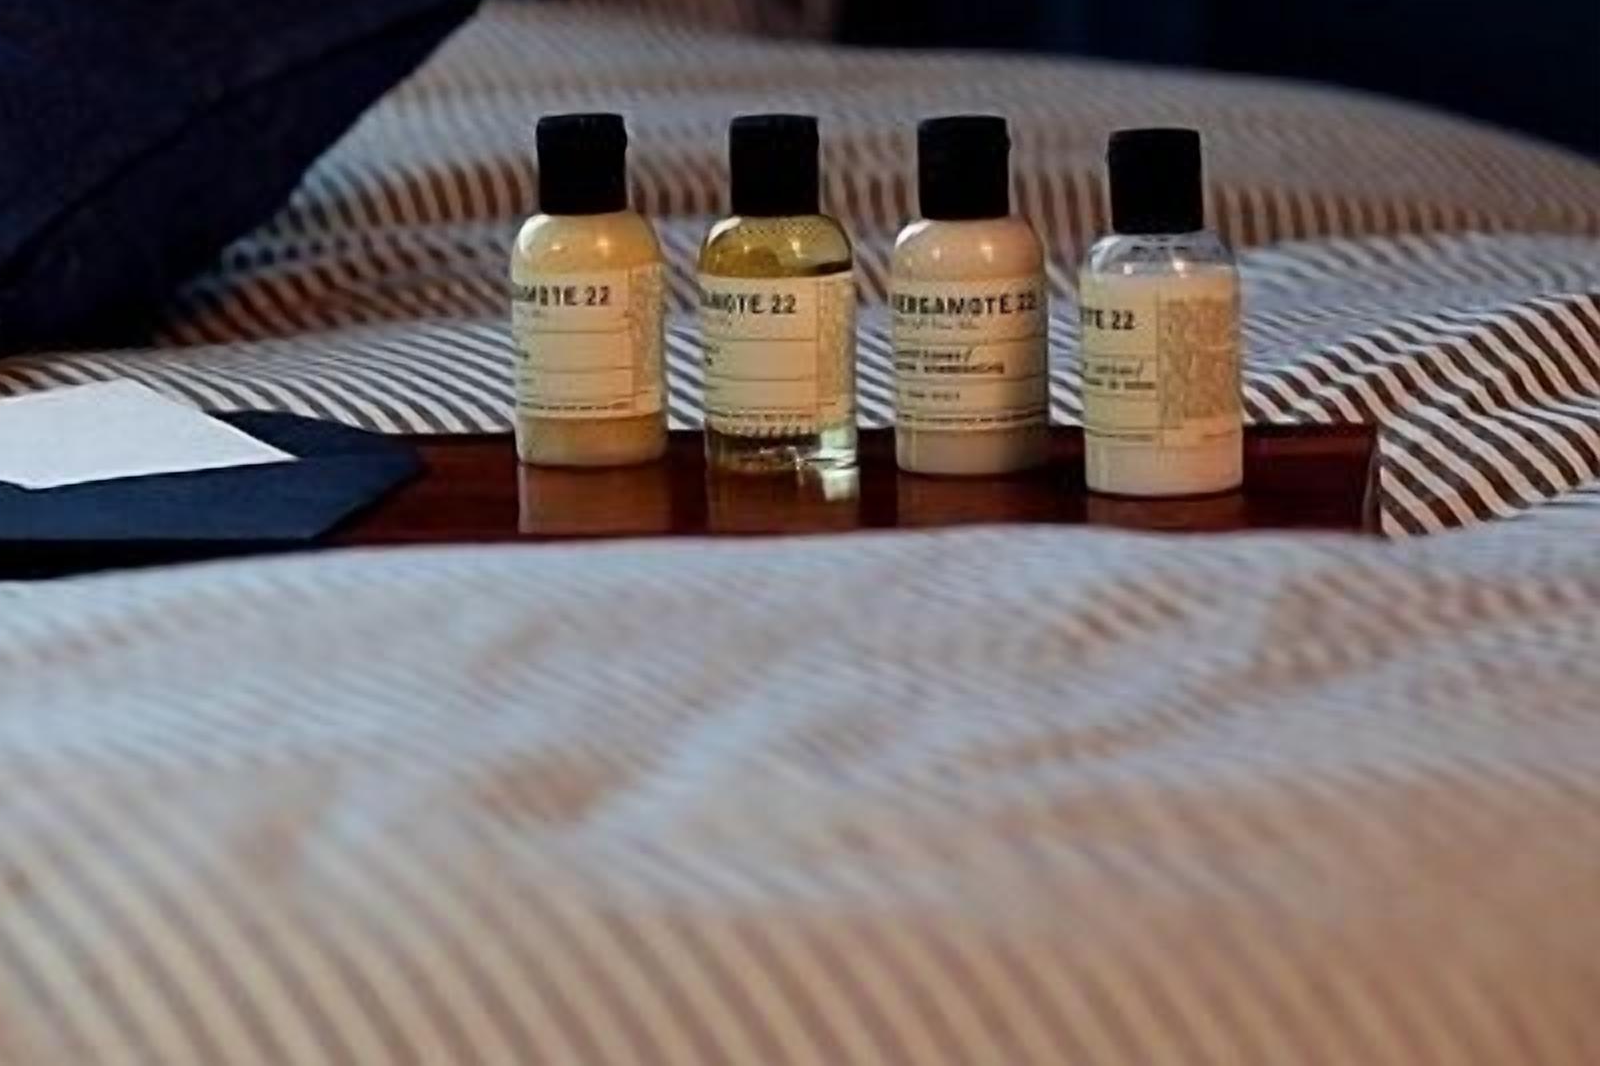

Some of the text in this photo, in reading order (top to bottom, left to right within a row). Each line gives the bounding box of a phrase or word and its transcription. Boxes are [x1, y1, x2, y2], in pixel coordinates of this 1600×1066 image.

[584, 285, 611, 307] 22
[771, 293, 797, 315] 22
[1112, 309, 1135, 331] 22
